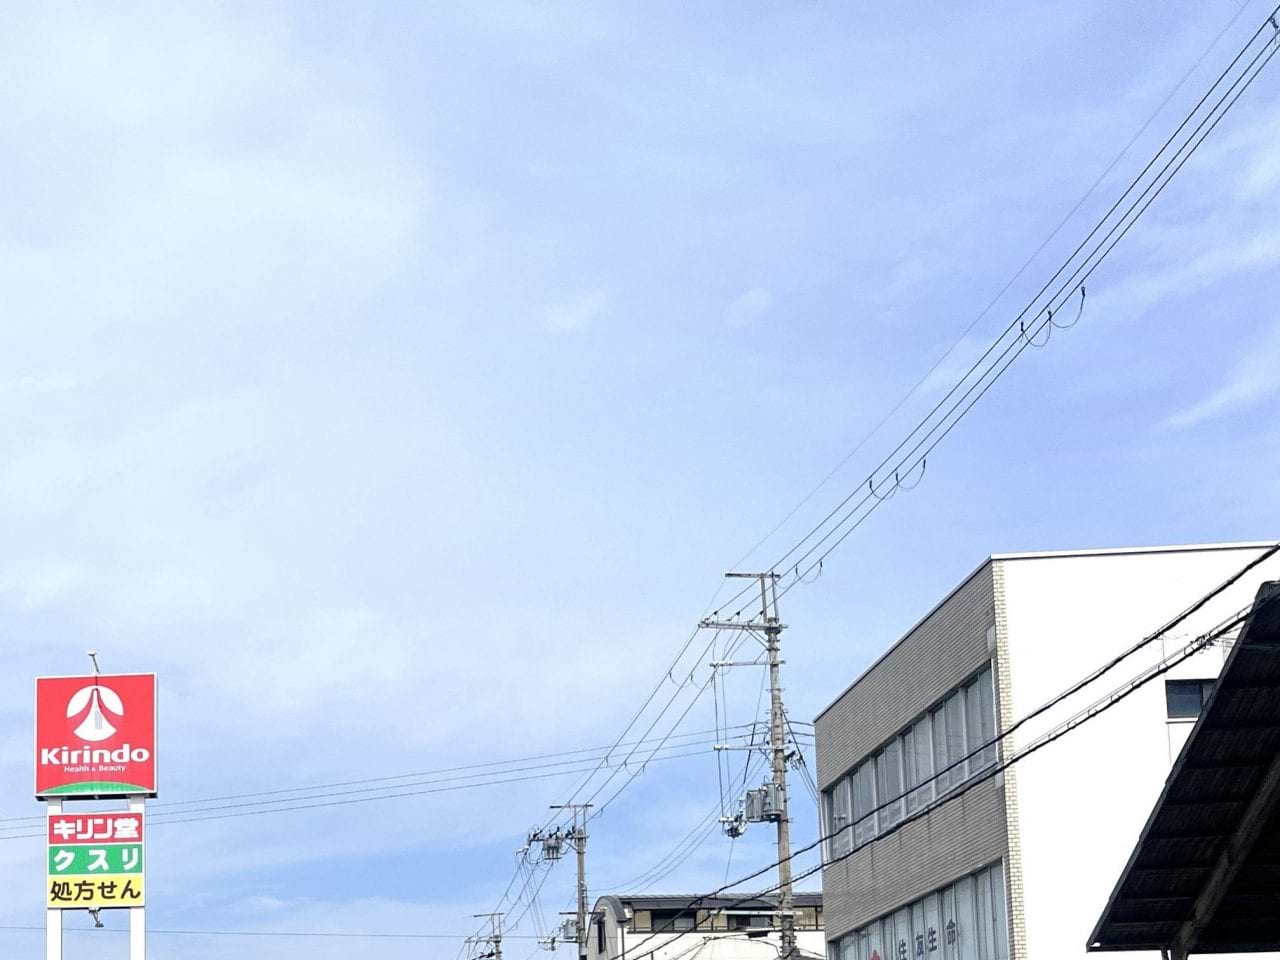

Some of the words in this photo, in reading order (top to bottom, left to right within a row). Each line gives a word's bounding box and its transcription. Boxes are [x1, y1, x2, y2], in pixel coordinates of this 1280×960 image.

[41, 743, 150, 765] Kirindo
[64, 764, 90, 773] Health
[98, 764, 126, 773] Beauty
[53, 817, 139, 840] キリン堂
[53, 848, 139, 871] クスリ
[50, 879, 141, 901] 処方せん
